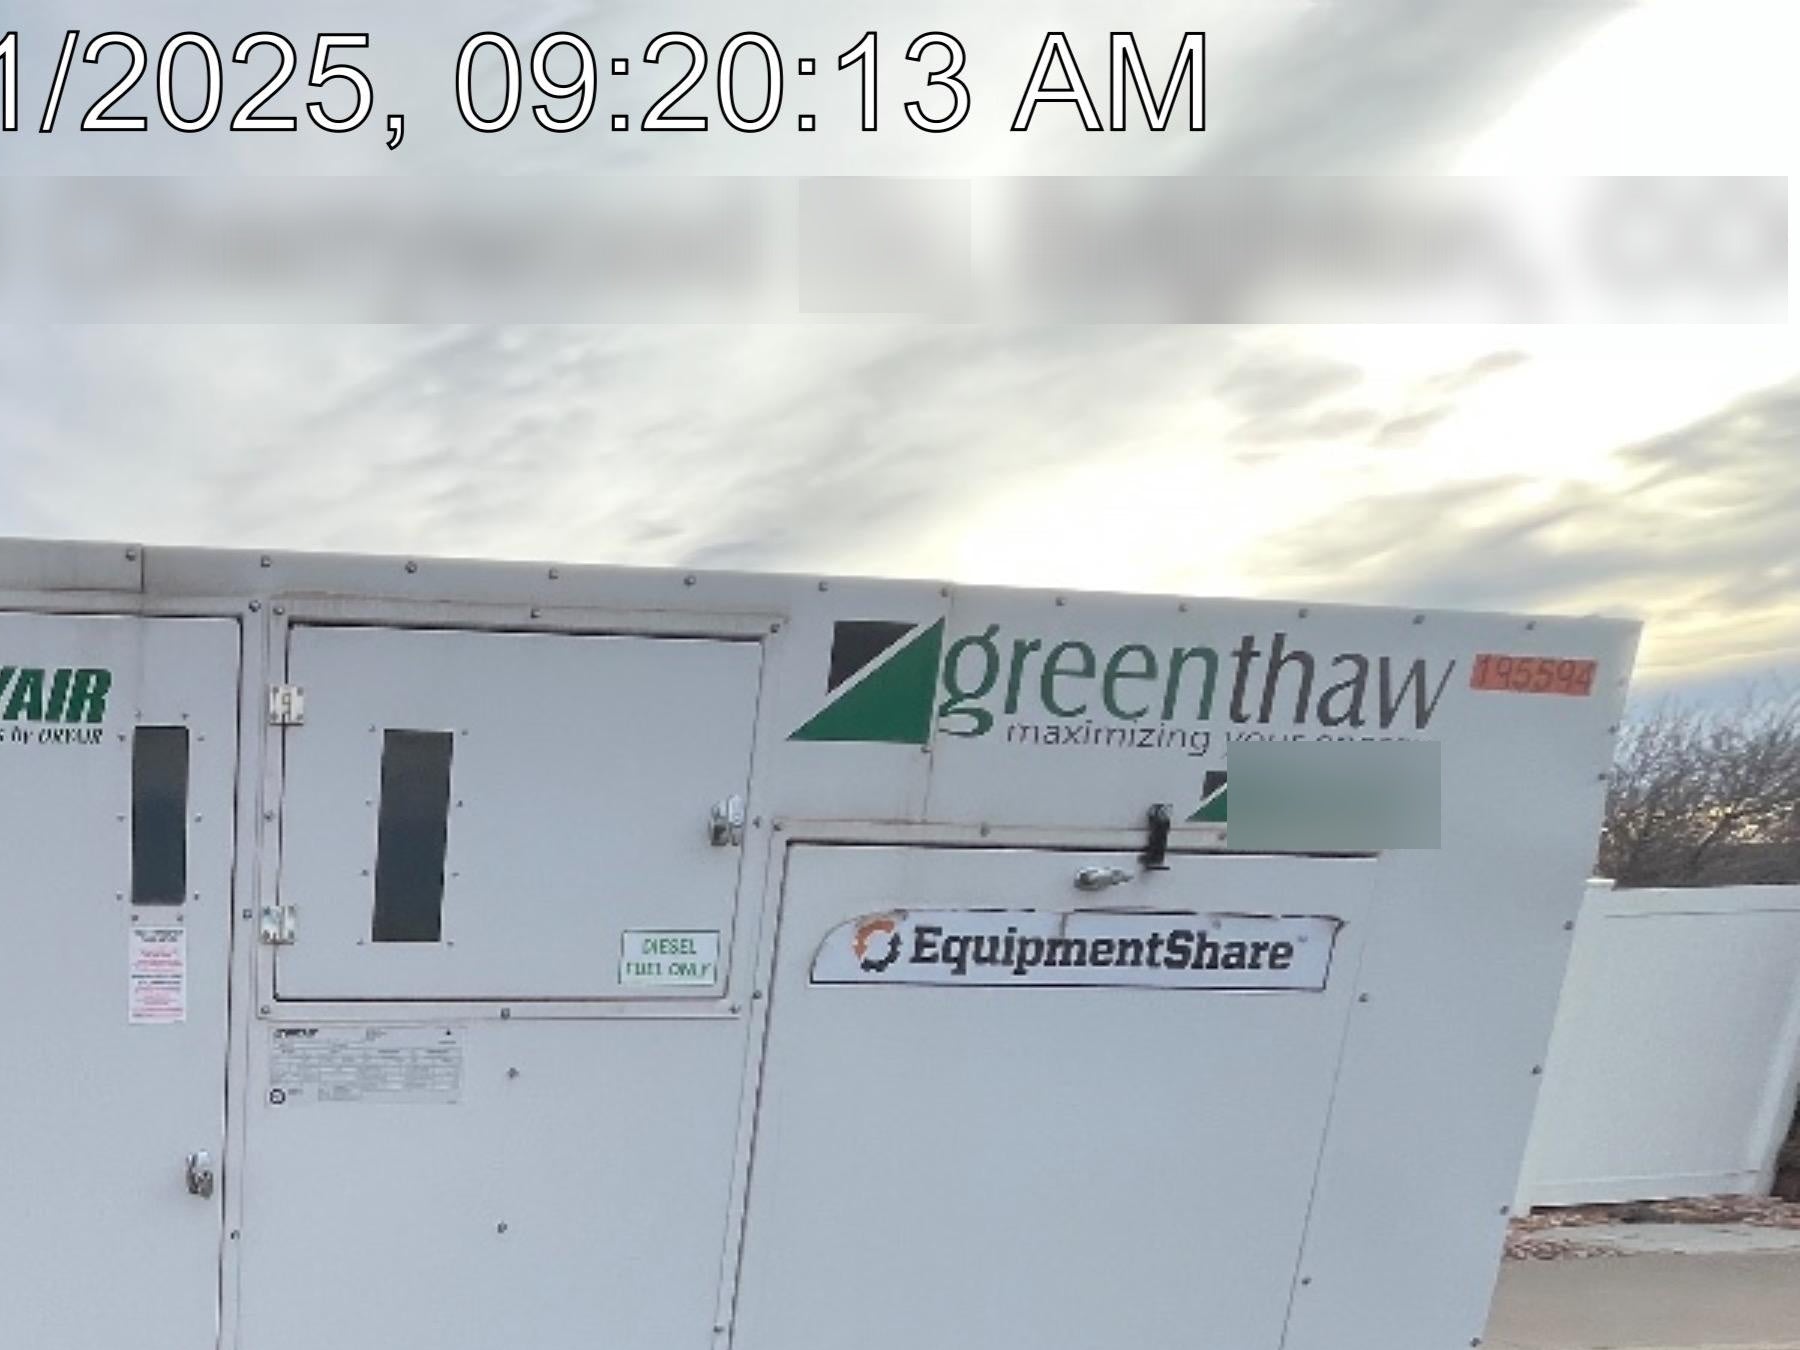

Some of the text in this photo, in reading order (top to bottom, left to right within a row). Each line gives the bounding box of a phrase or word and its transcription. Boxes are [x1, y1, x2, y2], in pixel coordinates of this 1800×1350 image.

[938, 623, 1456, 737] greenthaw
[1477, 655, 1595, 696] 195594
[1006, 720, 1211, 757] maximizing
[642, 938, 698, 955] DIESEL
[908, 926, 1295, 975] EquipmentShare
[626, 961, 712, 978] FUEL ONLY
